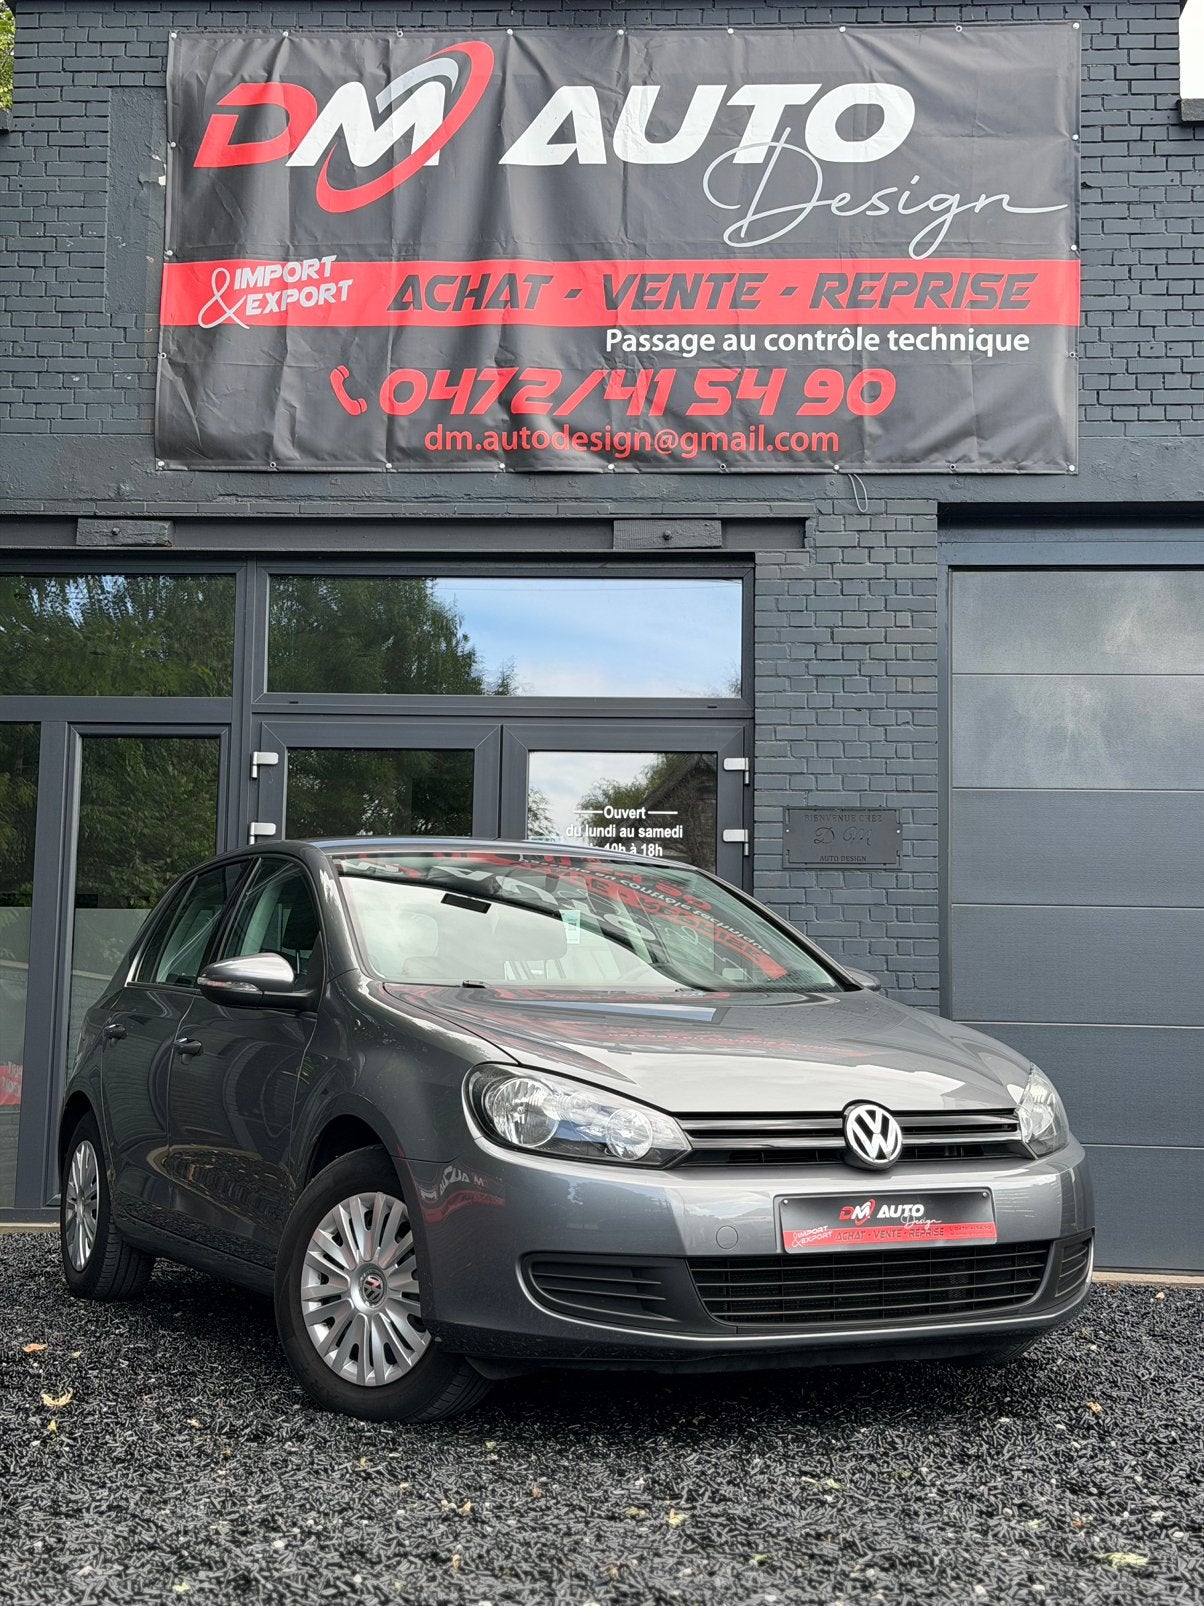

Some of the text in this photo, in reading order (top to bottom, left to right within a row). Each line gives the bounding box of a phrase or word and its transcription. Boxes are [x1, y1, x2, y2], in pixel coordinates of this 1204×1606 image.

[194, 81, 916, 168] DM AUTO
[703, 127, 1069, 260] Design
[233, 254, 337, 290] IMPORT
[198, 267, 354, 330] & EXPORT
[387, 273, 554, 312] ACHAT
[603, 273, 770, 312] VENTE
[808, 272, 1040, 310] REPRISE
[606, 327, 1030, 357] Passage au contrôle technique
[379, 367, 897, 416] 0472/41 54 90
[424, 424, 840, 459] dm.autodesign@gmail.com
[603, 805, 646, 819] Ouvert
[804, 814, 855, 822] BIENVENUE
[566, 824, 683, 838] du lundi au samedi
[640, 843, 663, 856] 18h
[876, 1204, 925, 1219] AUTO
[900, 1212, 942, 1228] Design
[797, 1225, 829, 1237] IMPORT
[801, 1232, 833, 1244] EXPORT
[835, 1231, 865, 1241] ACHAT
[873, 1229, 901, 1239] VENTE
[909, 1227, 945, 1238] REPRISE
